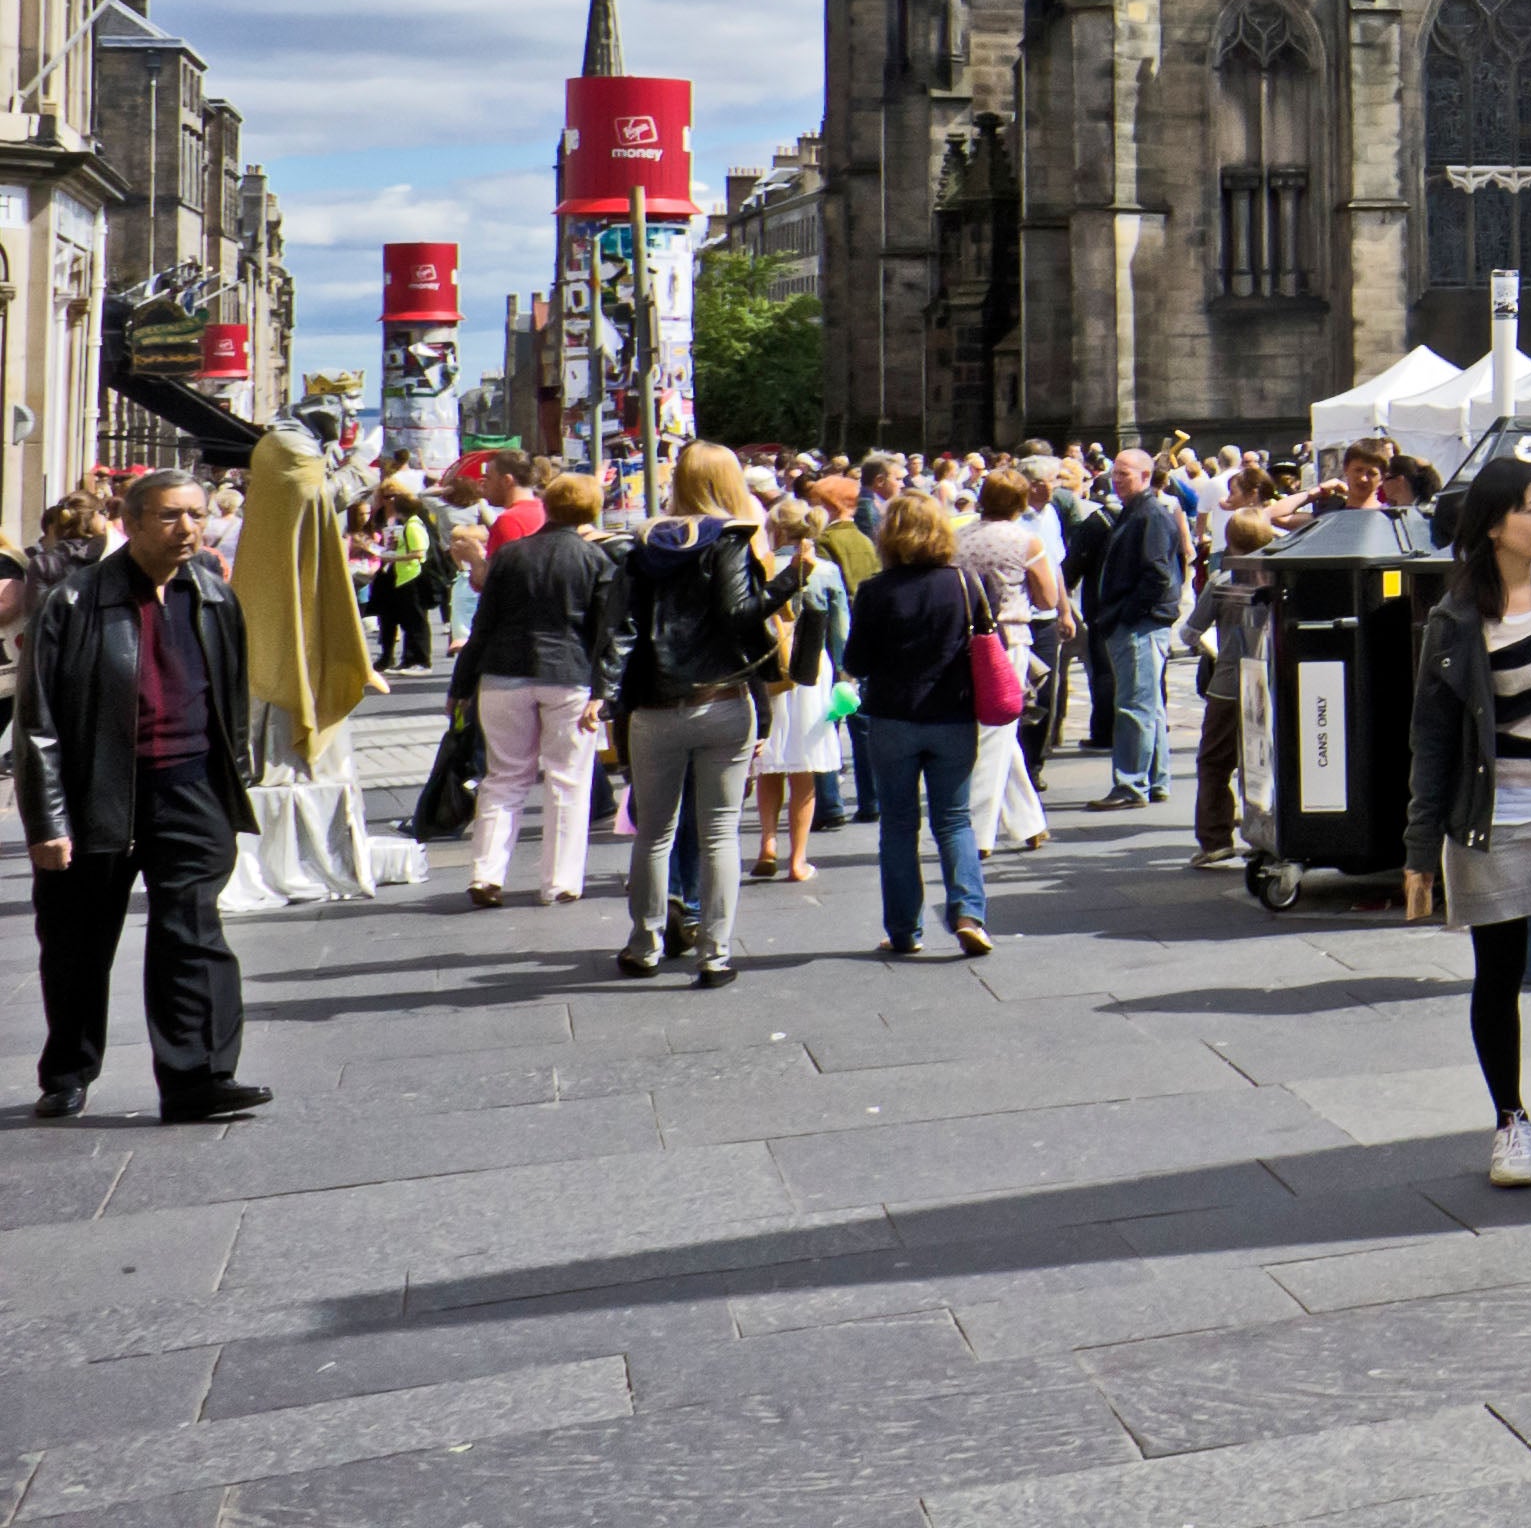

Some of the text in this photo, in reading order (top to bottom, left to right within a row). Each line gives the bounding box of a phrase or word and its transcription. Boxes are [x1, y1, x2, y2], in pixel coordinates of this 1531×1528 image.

[611, 148, 663, 162] money
[1317, 696, 1329, 768] CANS ONLY
